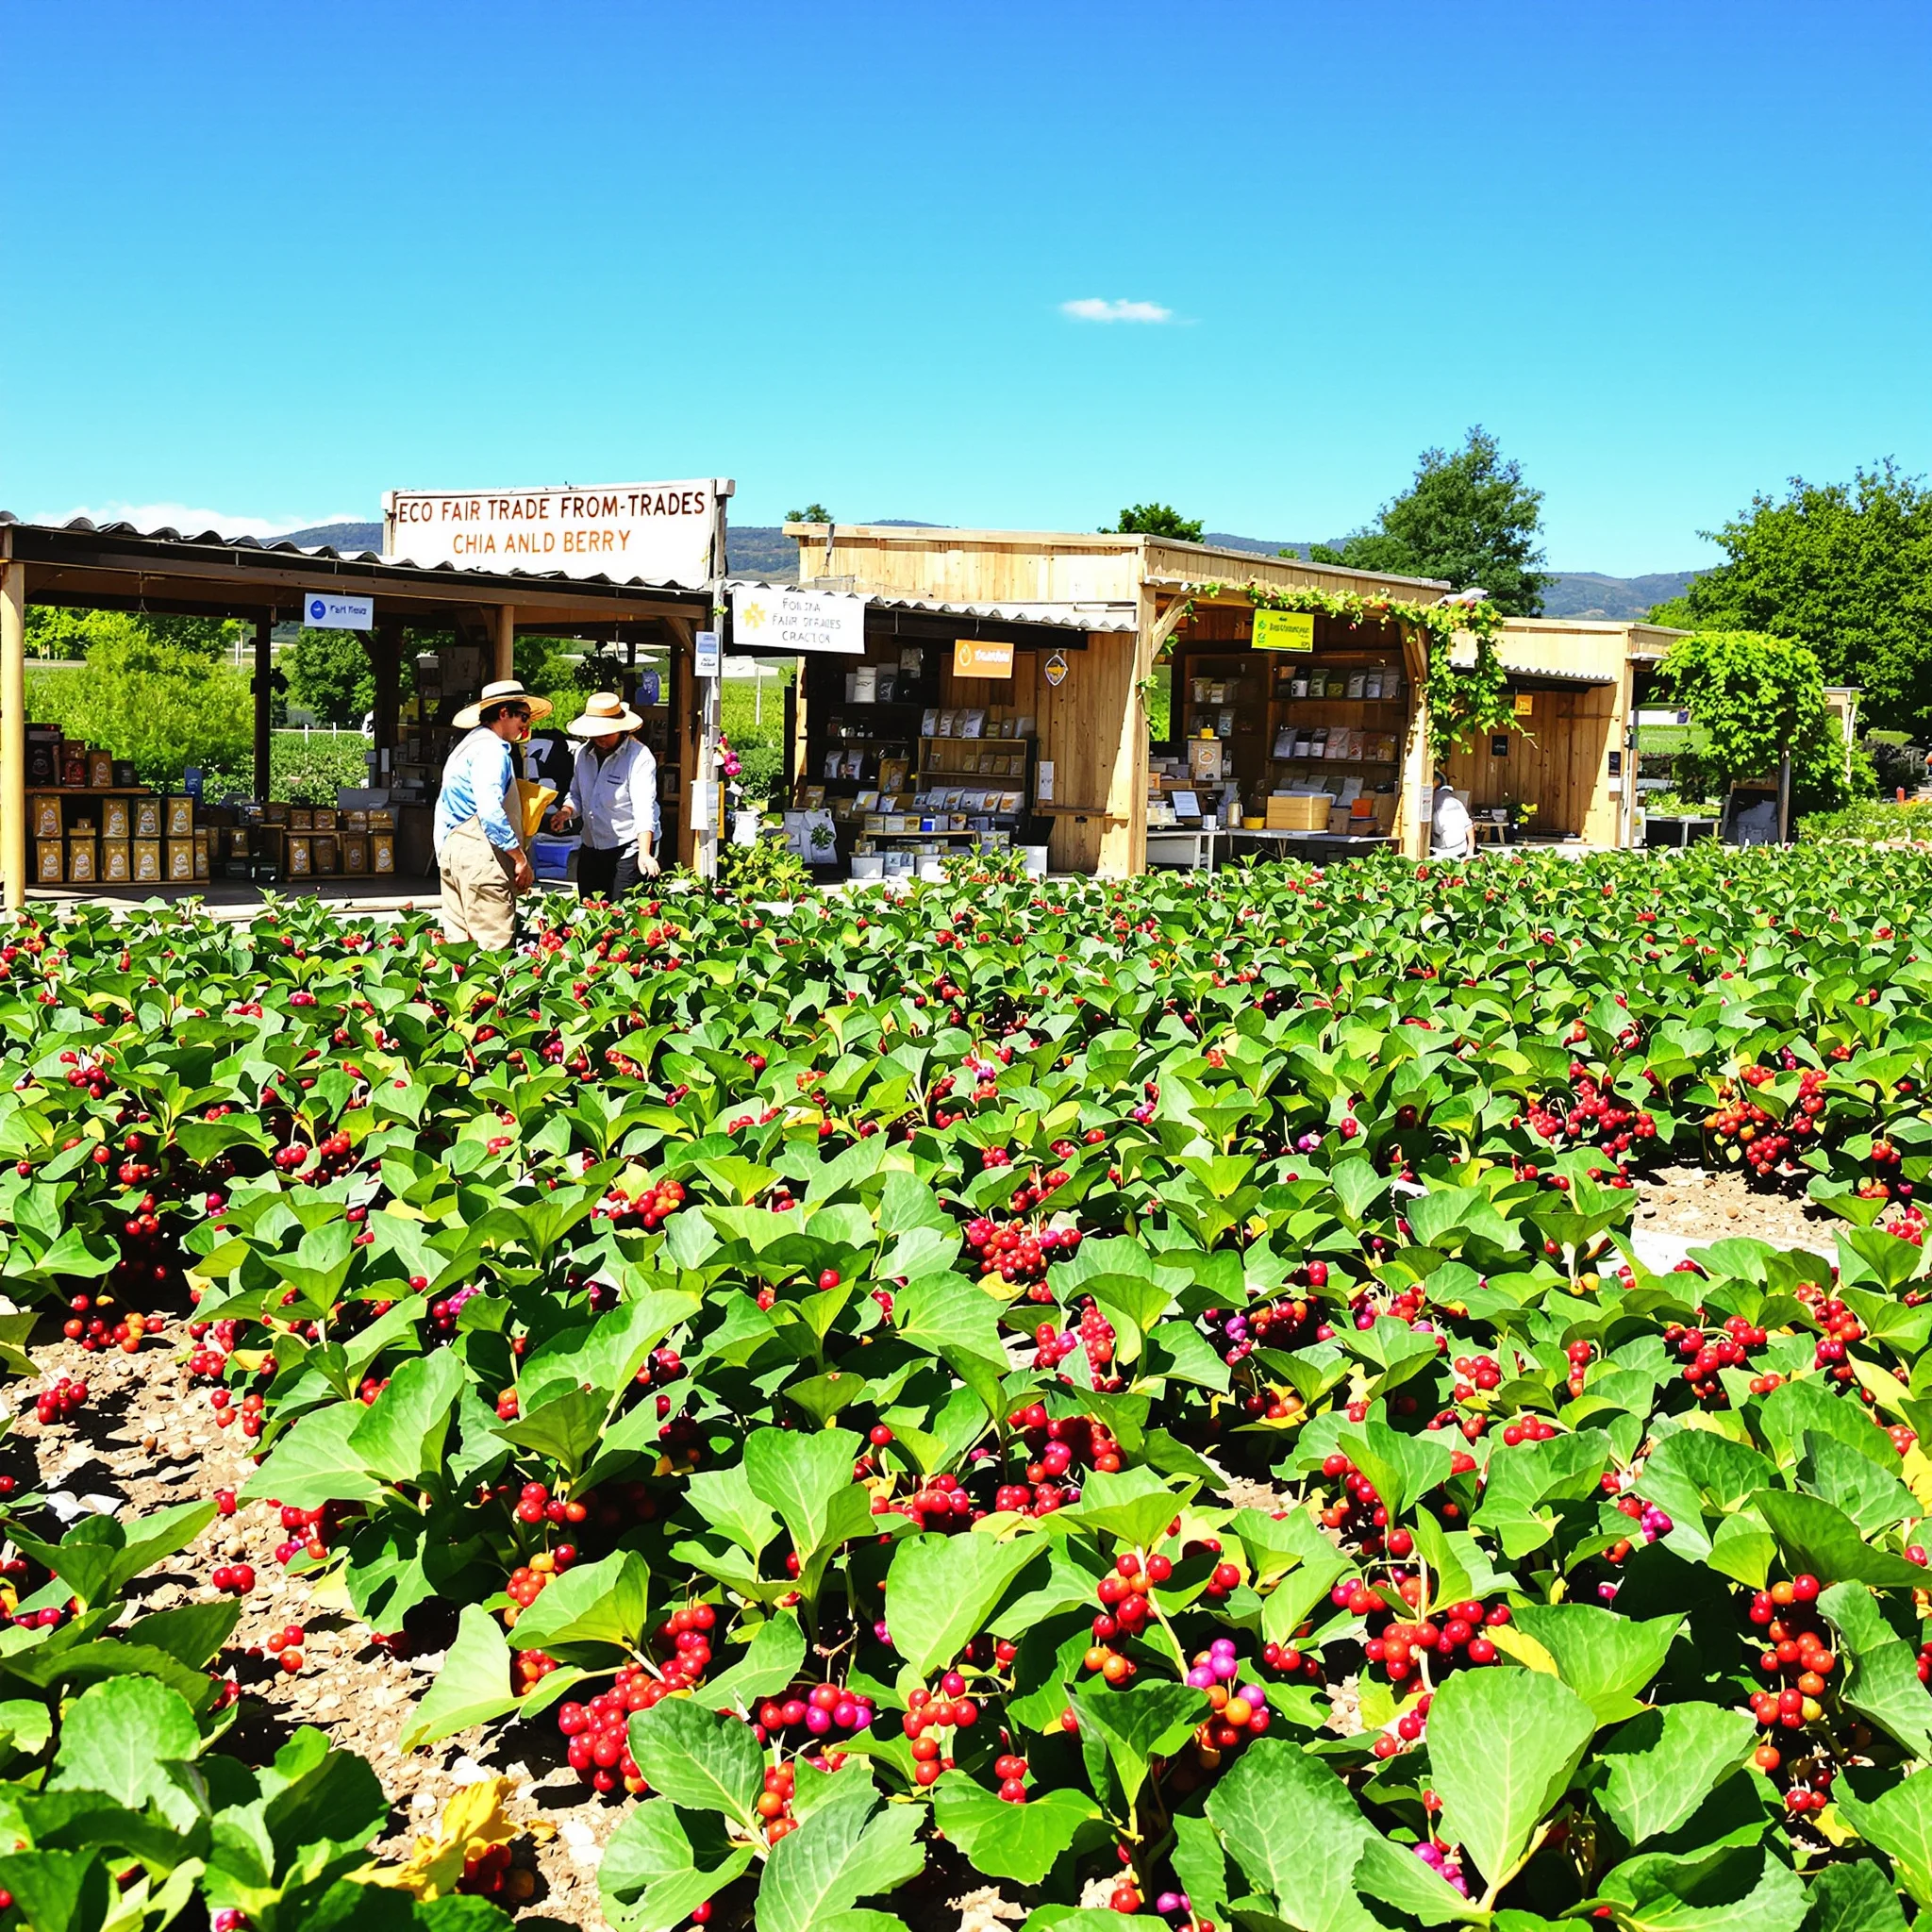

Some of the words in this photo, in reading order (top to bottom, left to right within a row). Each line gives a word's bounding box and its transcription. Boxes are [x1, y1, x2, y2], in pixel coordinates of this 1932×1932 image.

[398, 502, 433, 523] ECO
[441, 500, 480, 522] FAIR
[488, 498, 550, 520] TRADE
[560, 491, 706, 518] FROM-TRADES
[453, 533, 496, 554] CHIA
[504, 532, 556, 553] ANLD
[563, 529, 631, 553] BERRY
